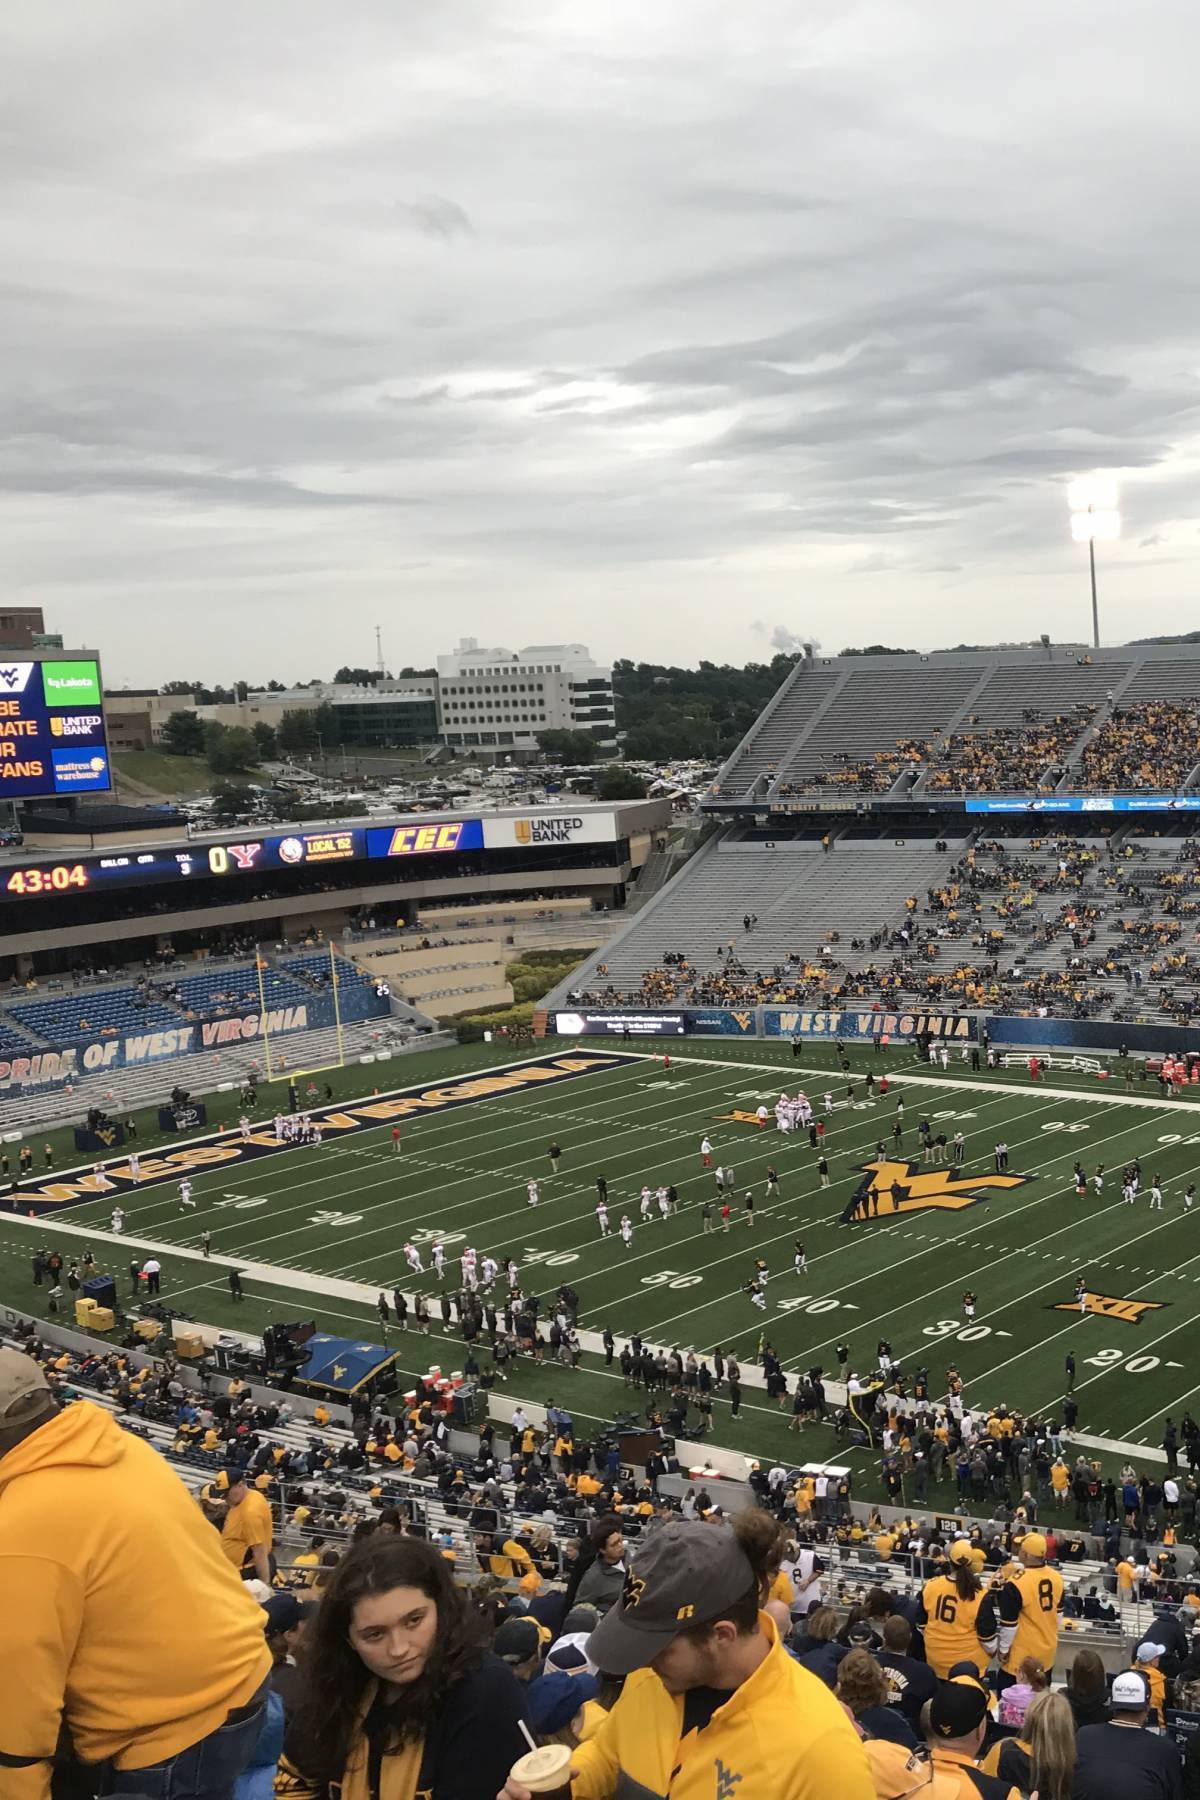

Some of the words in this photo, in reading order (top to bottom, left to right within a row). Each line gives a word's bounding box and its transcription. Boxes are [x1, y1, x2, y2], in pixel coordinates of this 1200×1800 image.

[61, 677, 93, 687] Lakota
[62, 716, 101, 726] UNITED
[64, 725, 93, 735] BANK
[55, 763, 91, 772] mattress
[56, 770, 100, 781] warehouse
[531, 818, 583, 831] UNITED
[389, 823, 463, 856] CEC
[532, 829, 570, 842] BANK
[307, 840, 336, 853] LOCAL
[335, 837, 352, 850] 152
[209, 847, 227, 873] 0
[227, 843, 261, 868] Y
[180, 863, 191, 875] 3
[7, 865, 87, 893] 43:04
[377, 984, 390, 997] 25
[780, 1012, 842, 1033] WEST
[858, 1014, 971, 1036] VIRGINIA
[83, 1041, 120, 1068] OF
[125, 1027, 194, 1061] WEST
[201, 1005, 309, 1046] VIRGINIA
[18, 1126, 290, 1204] WEST
[312, 1056, 620, 1133] VIRGINIA
[224, 1193, 269, 1211] 10
[309, 1211, 364, 1227] 20
[412, 1229, 467, 1245] 30
[524, 1249, 580, 1267] 40
[641, 1270, 704, 1290] 50
[776, 1294, 841, 1315] 40
[922, 1319, 994, 1342] 30
[1085, 1348, 1162, 1374] 20
[941, 1518, 957, 1531] 128
[792, 1568, 802, 1584] 8
[1038, 1578, 1053, 1612] 8
[676, 1604, 695, 1620] R
[935, 1593, 958, 1623] 16
